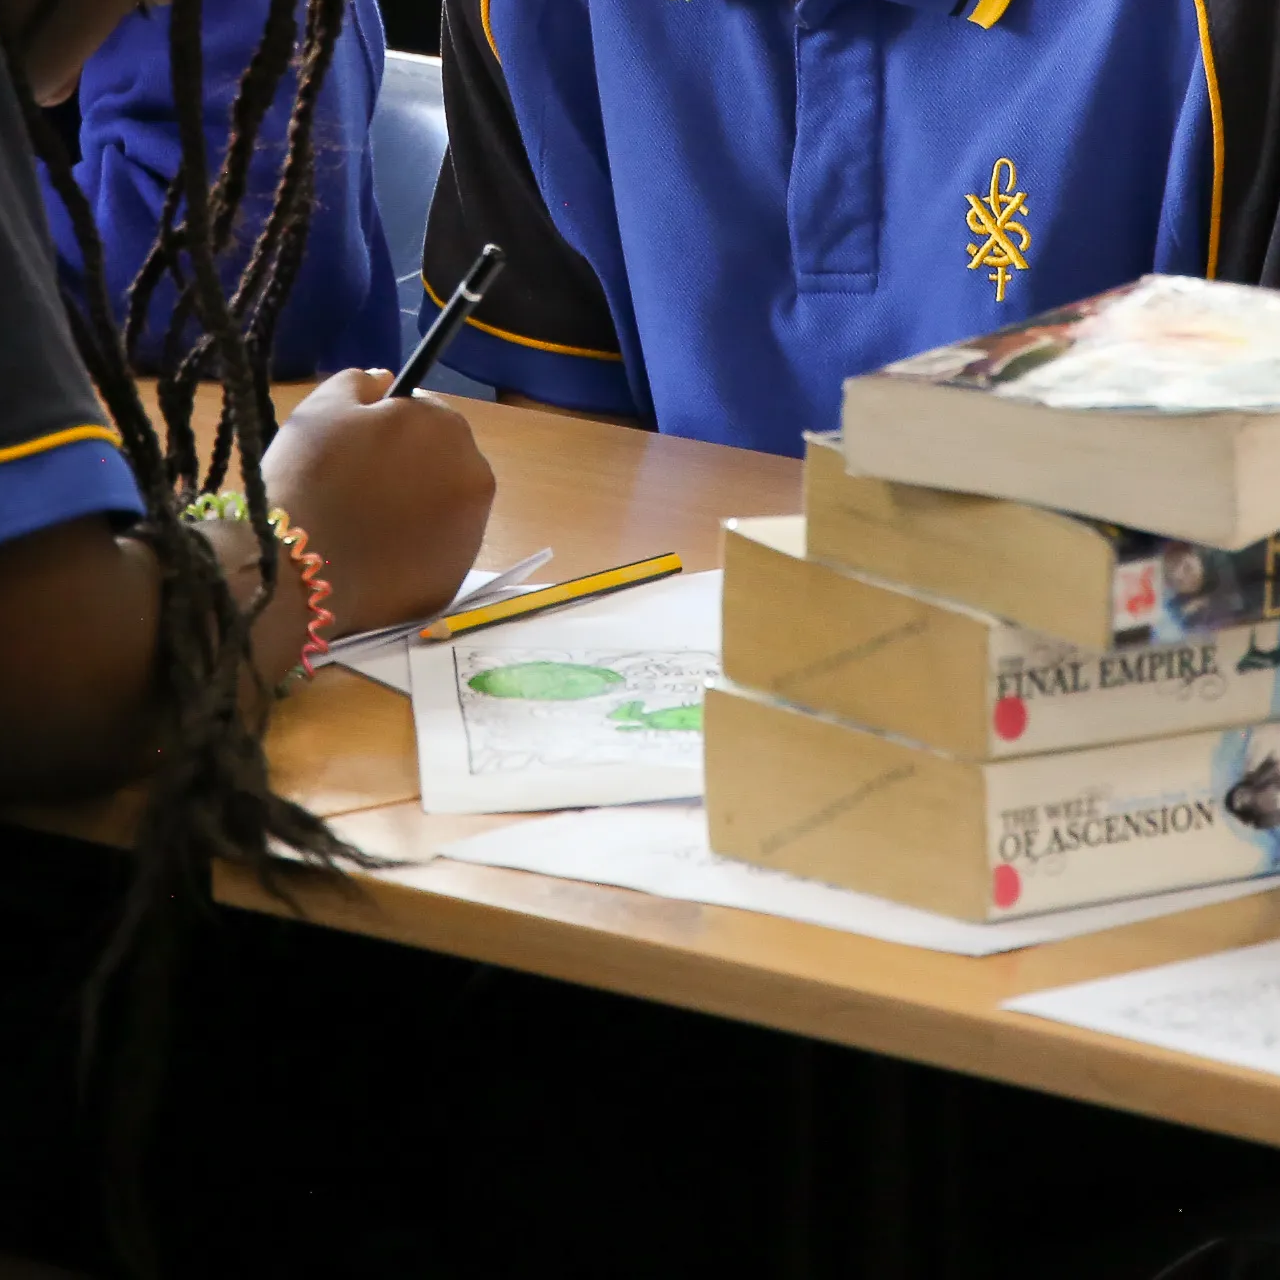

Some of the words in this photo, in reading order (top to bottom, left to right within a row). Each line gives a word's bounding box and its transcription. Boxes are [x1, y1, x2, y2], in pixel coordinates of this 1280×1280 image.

[996, 660, 1092, 702] FINAL
[1099, 646, 1219, 690] EMPIRE
[1048, 797, 1219, 855] ASCENSION
